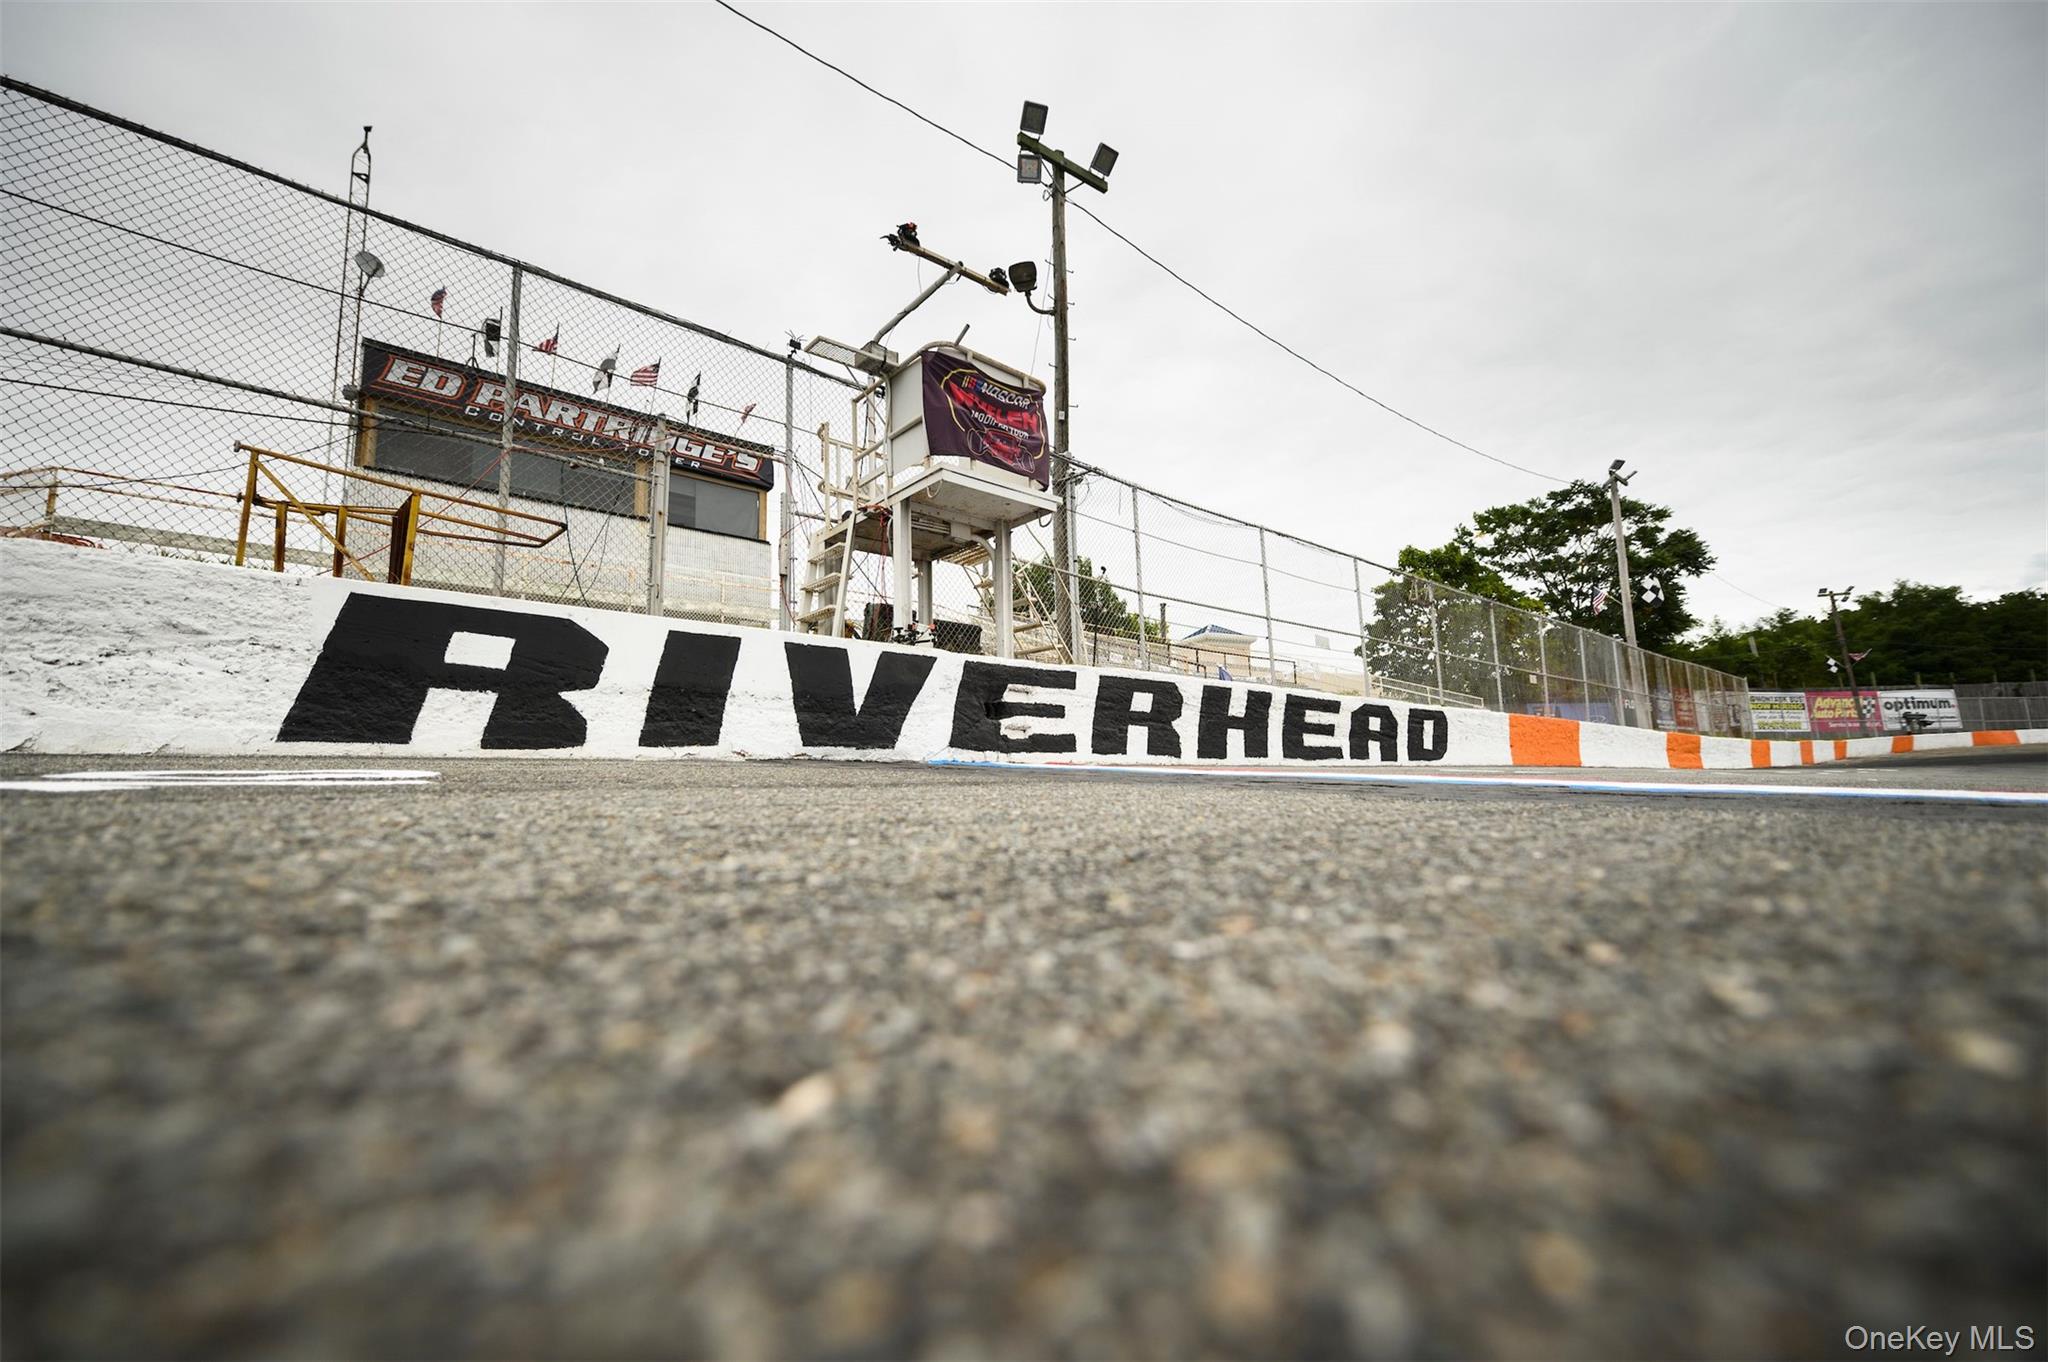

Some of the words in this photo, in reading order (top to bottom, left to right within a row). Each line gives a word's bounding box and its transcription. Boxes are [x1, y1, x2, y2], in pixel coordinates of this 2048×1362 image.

[383, 358, 463, 398] ED
[981, 382, 1031, 410] NASCAR
[622, 440, 701, 469] TOER
[276, 591, 1449, 762] RIVERHEAD
[1814, 696, 1856, 709] Advanc
